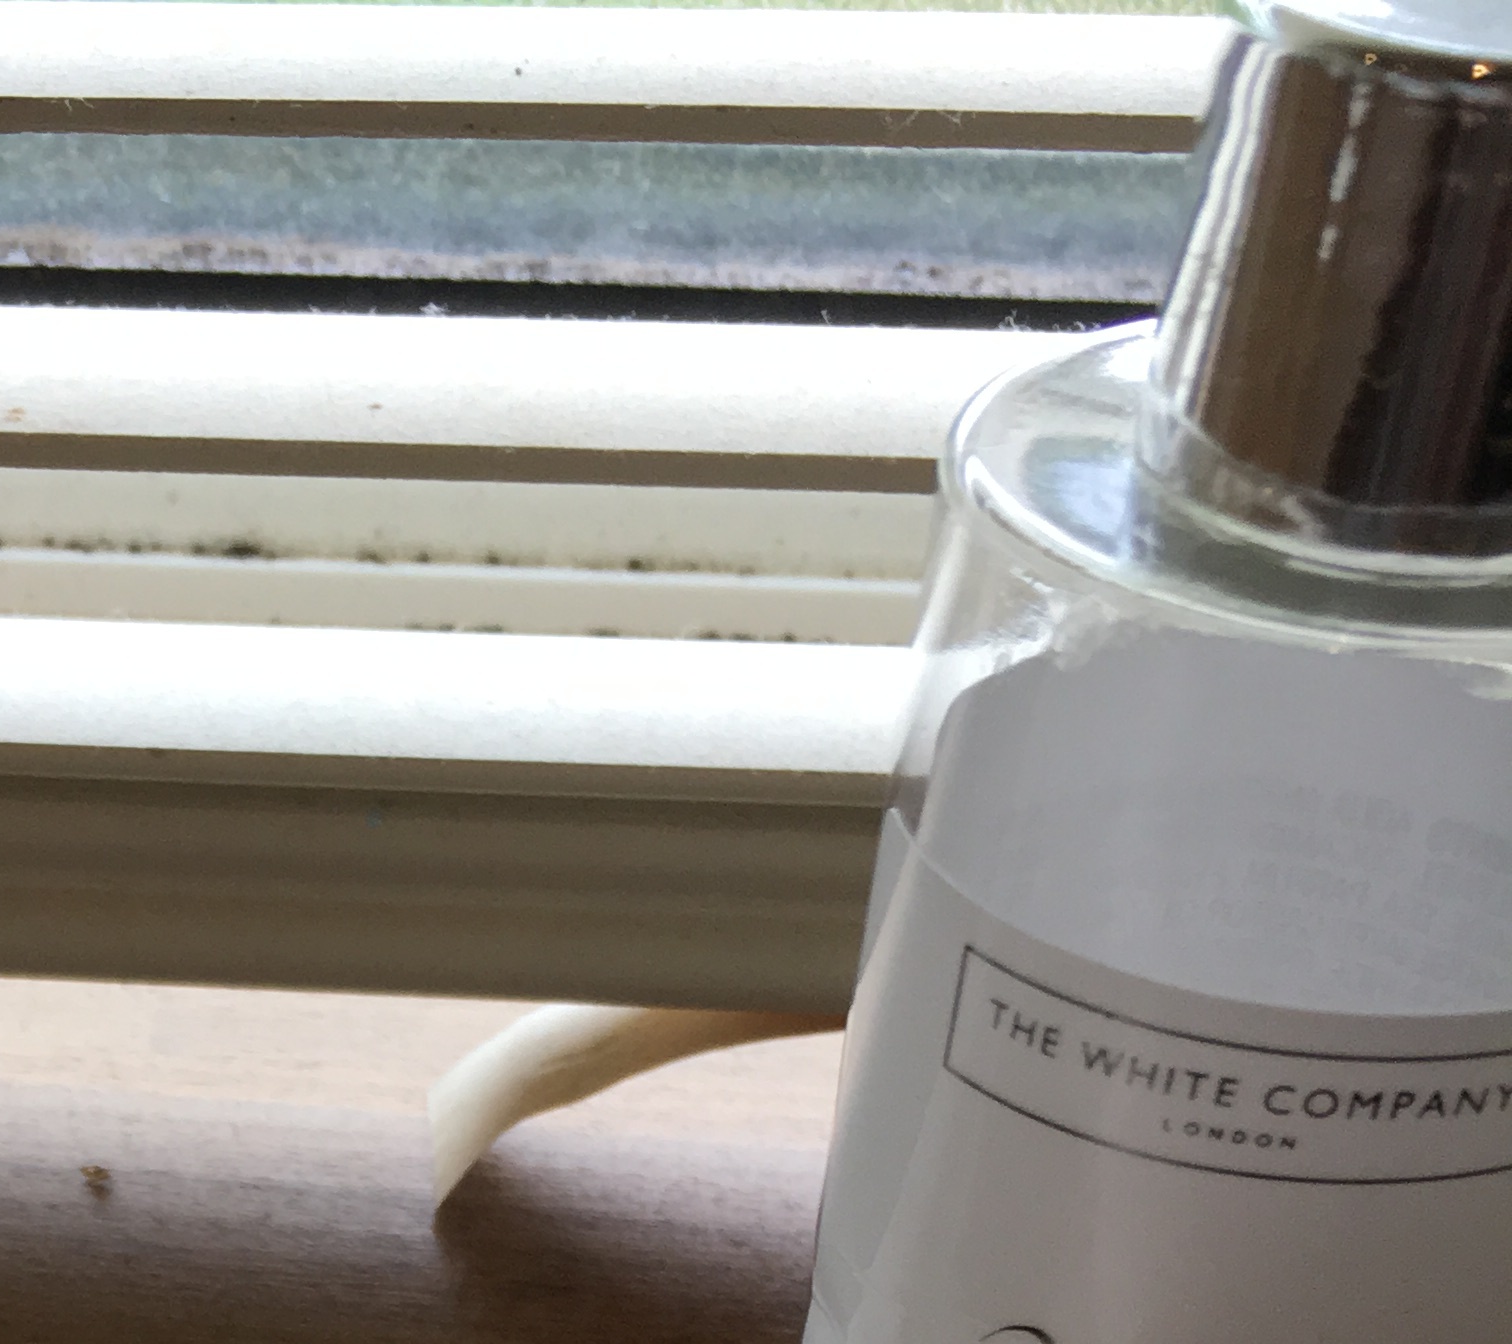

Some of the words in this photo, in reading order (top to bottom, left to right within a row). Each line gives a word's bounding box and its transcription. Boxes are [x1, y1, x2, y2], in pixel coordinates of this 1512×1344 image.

[988, 999, 1059, 1059] THE
[1081, 1041, 1240, 1108] WHITE
[1162, 1118, 1297, 1150] LONDON
